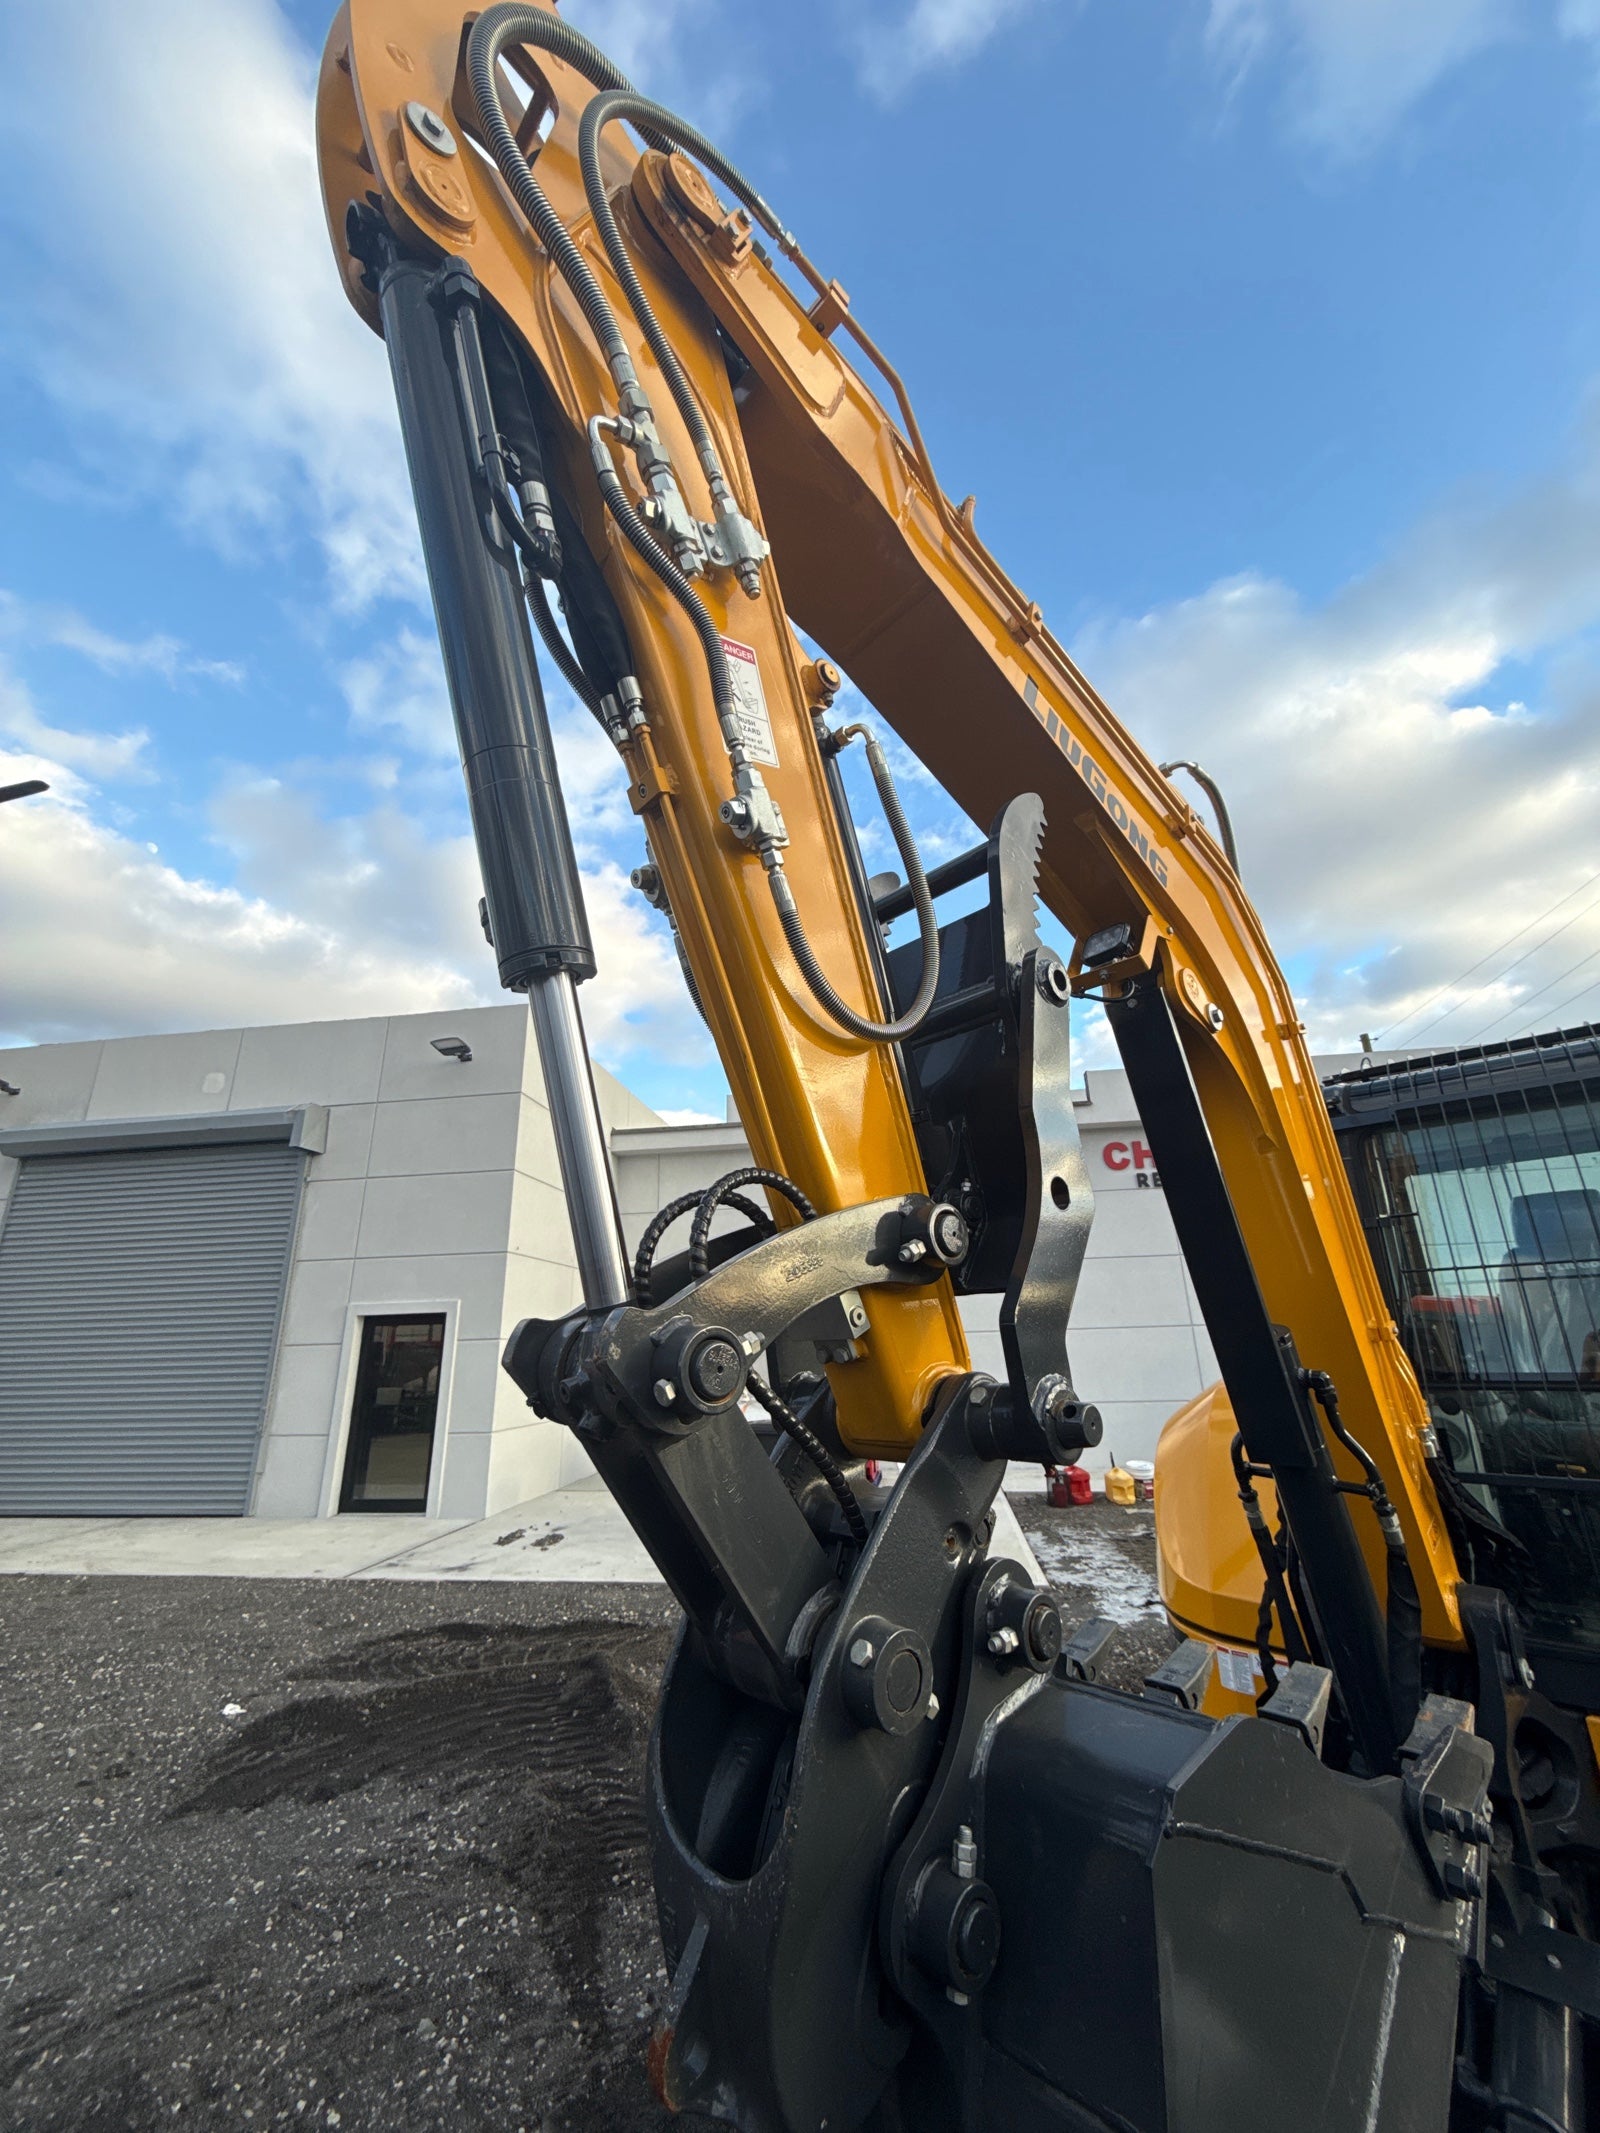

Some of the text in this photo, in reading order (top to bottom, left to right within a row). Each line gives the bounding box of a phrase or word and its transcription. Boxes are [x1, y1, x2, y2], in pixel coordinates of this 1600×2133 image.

[723, 643, 755, 662] ANGER
[739, 716, 756, 726] RUSH
[742, 725, 761, 736] ZARD
[1023, 674, 1168, 888] LIUGONG
[1102, 1141, 1157, 1171] CH
[1136, 1172, 1164, 1188] RE
